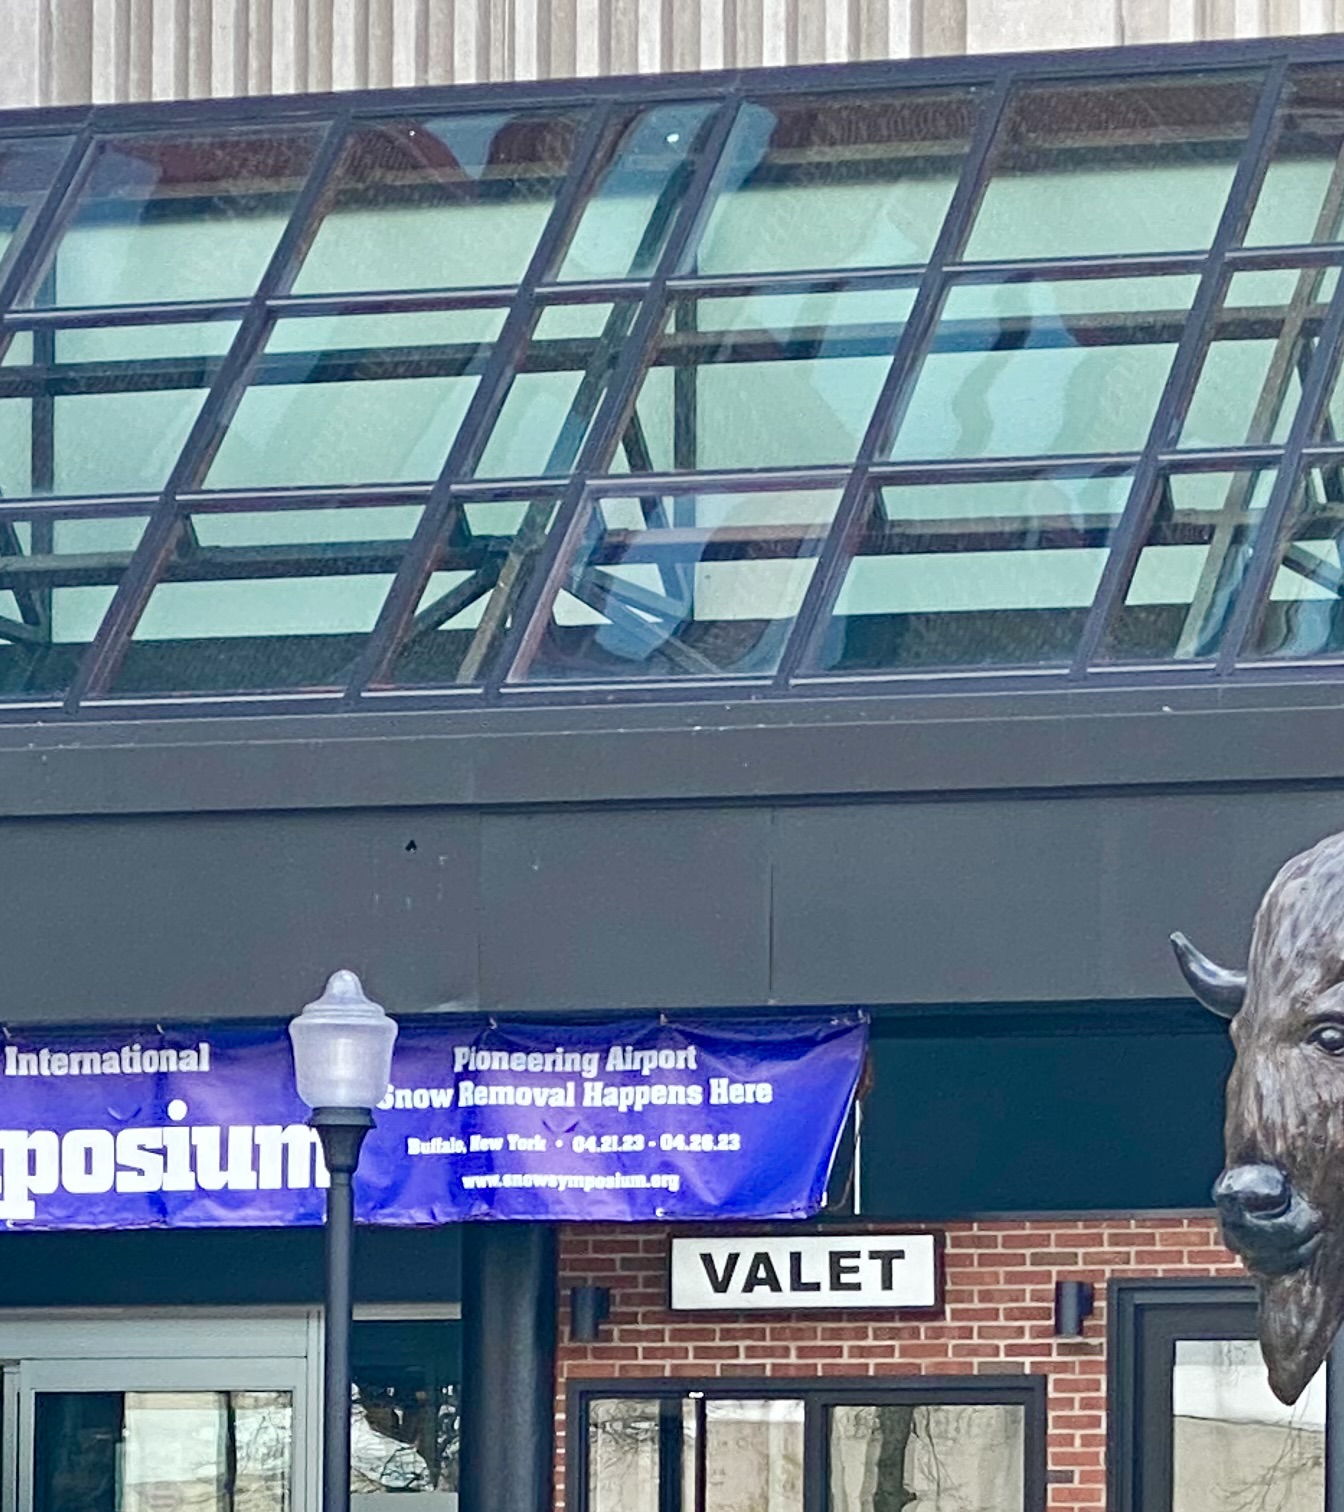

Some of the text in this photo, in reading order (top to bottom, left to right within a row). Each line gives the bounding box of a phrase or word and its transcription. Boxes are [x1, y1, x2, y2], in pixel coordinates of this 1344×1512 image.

[5, 1043, 210, 1076] International
[454, 1045, 697, 1079] Pioneering Airport
[376, 1078, 773, 1112] Snow Removal Happens Here
[407, 1136, 467, 1155] Buffalo,
[469, 1134, 504, 1152] New
[507, 1133, 547, 1152] York
[699, 1249, 906, 1294] VALET
